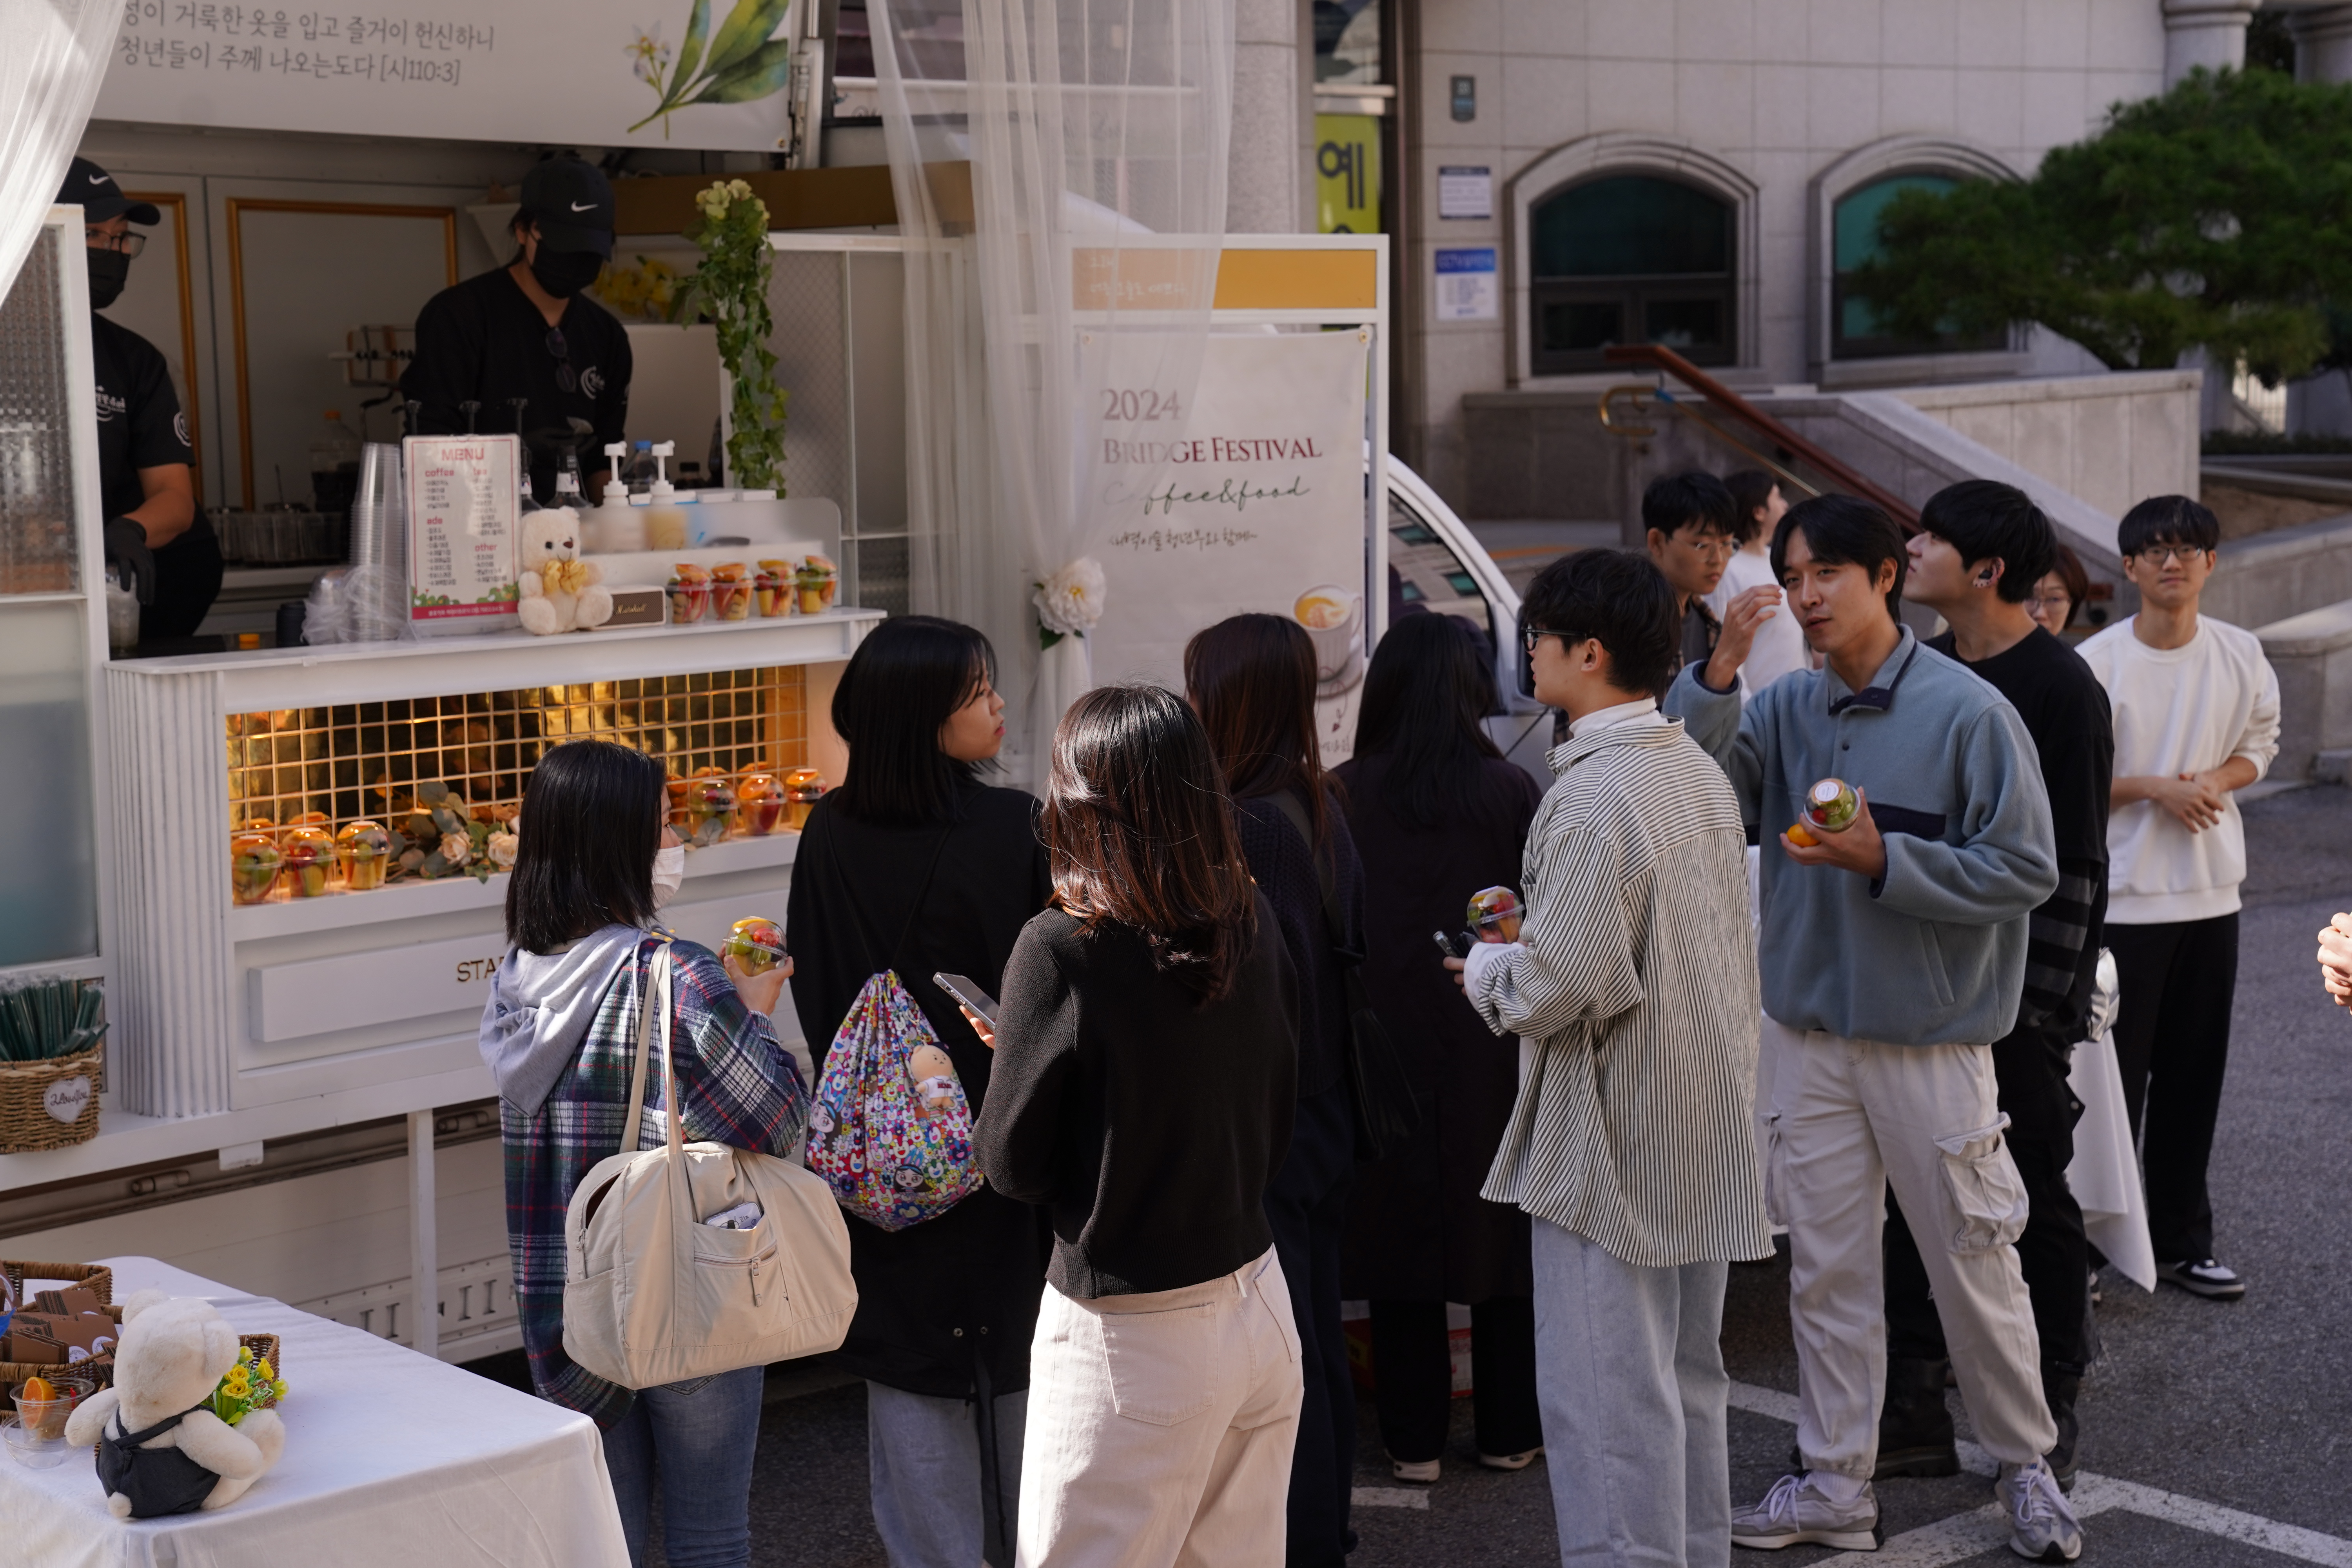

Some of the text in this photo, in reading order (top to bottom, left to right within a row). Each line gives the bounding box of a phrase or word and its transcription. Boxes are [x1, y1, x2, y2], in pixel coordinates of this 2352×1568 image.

[175, 1, 243, 35] 거룩한
[248, 9, 291, 38] 옷을
[299, 12, 340, 40] 입고
[346, 16, 407, 45] 즐거이
[415, 20, 494, 51] 헌신하니
[119, 36, 210, 69] 청년들이
[217, 45, 261, 72] 주께
[270, 47, 376, 79] 나오는도다
[1101, 389, 1180, 421] 2024
[441, 448, 485, 461] MENU
[1103, 436, 1323, 464] BRIDGE FESTIVAL
[425, 468, 455, 477] coffee
[1102, 475, 1310, 515] Cffee&food
[474, 543, 498, 552] other
